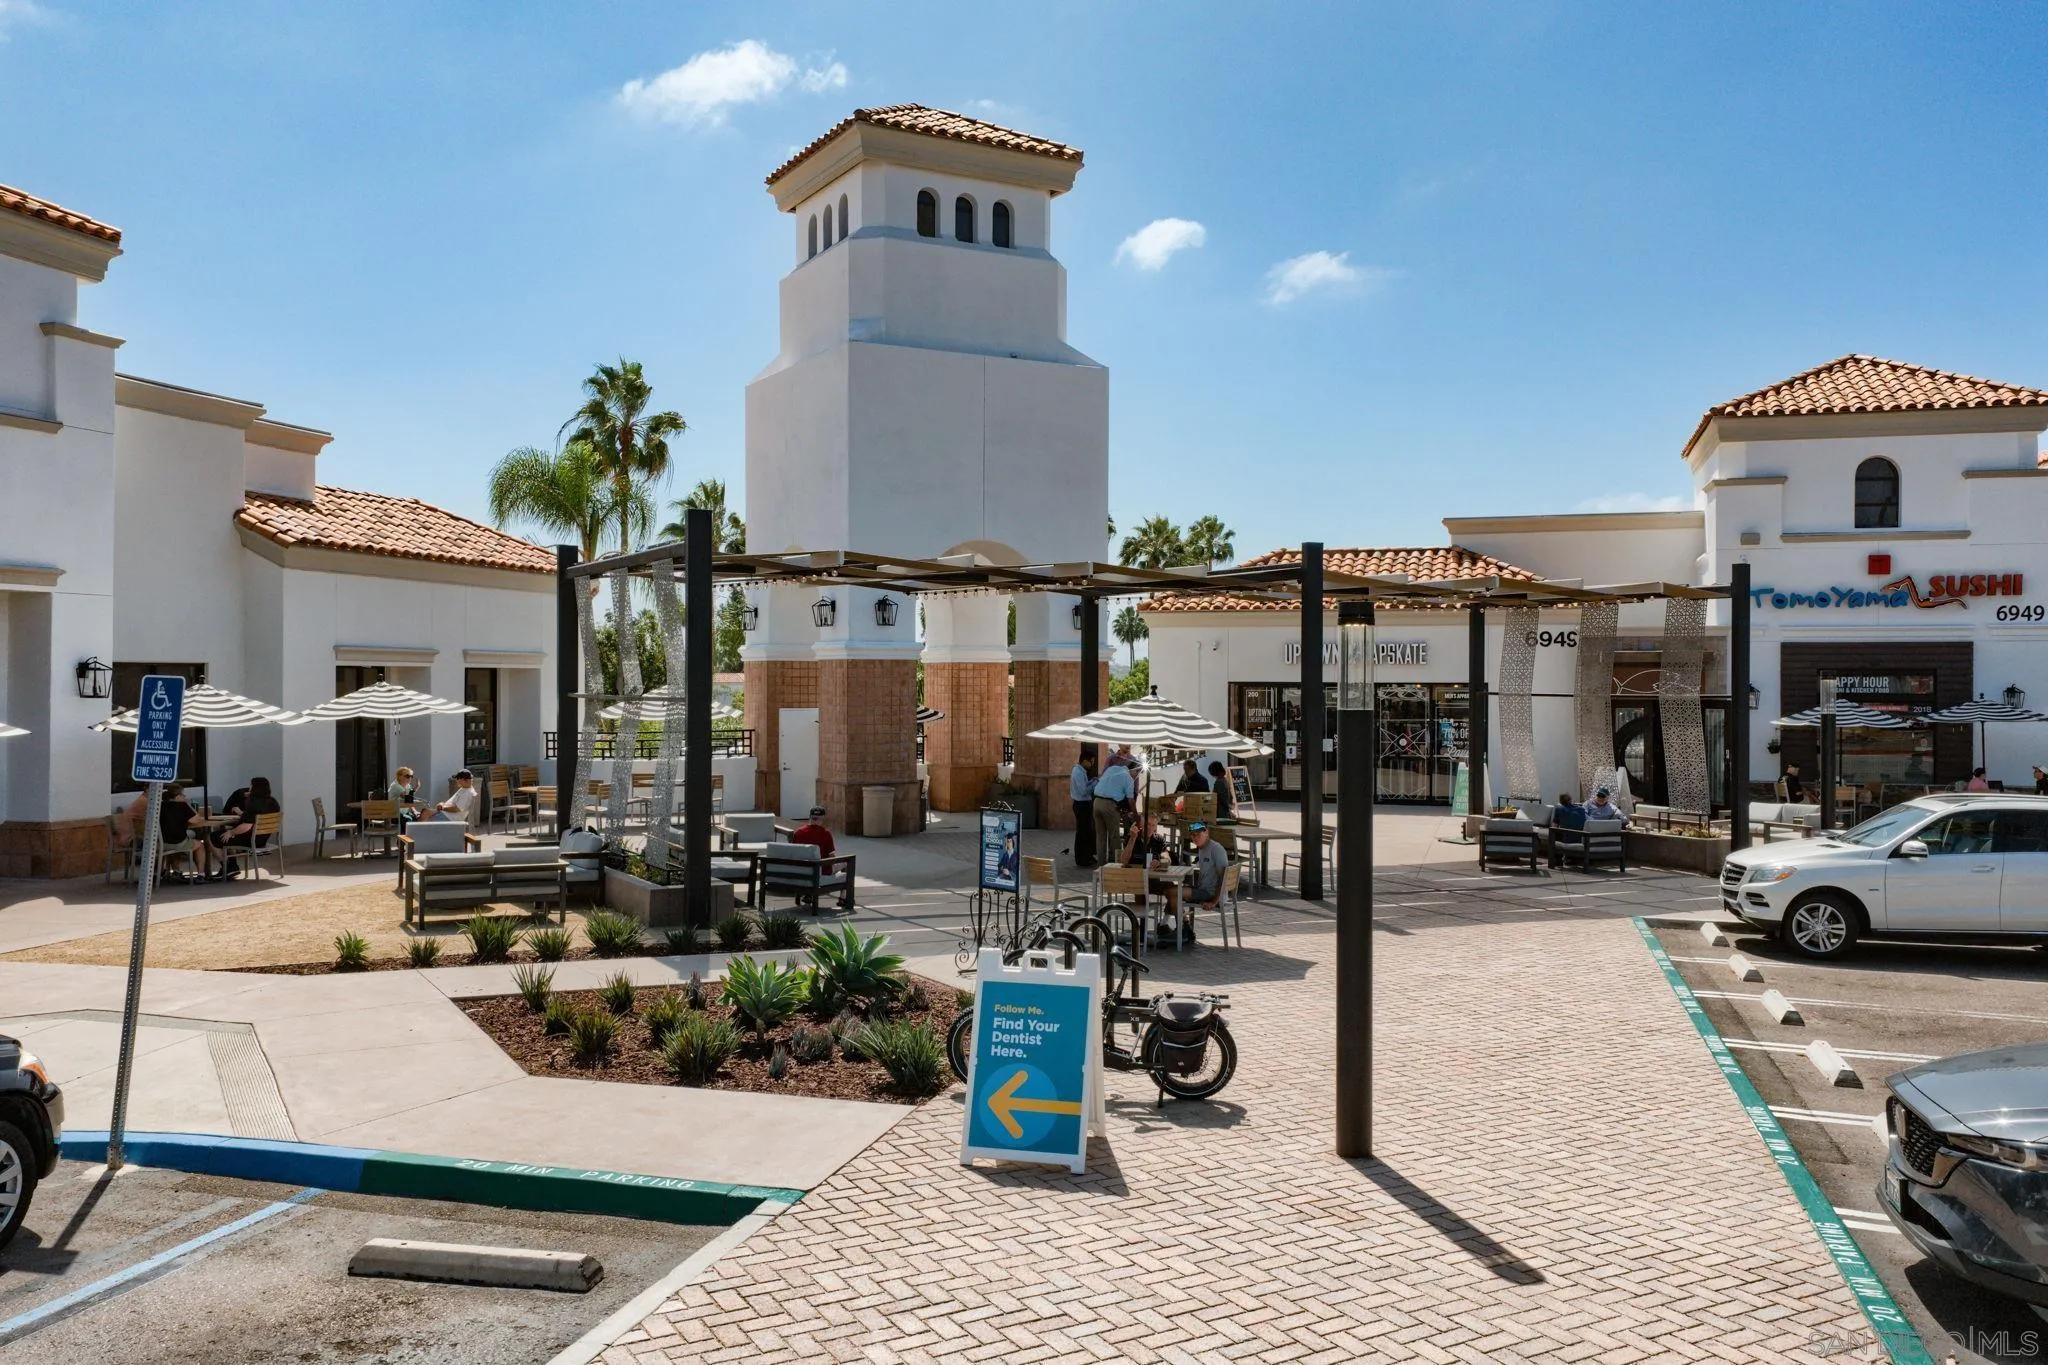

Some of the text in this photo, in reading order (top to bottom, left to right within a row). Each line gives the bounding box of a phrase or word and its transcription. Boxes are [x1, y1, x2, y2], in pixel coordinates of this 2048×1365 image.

[1929, 573, 2023, 598] SUSHI
[1996, 605, 2045, 622] 6949
[1284, 643, 1339, 665] UPWN
[1835, 676, 1889, 688] APPY HOUR
[148, 710, 173, 721] PARKING
[1248, 708, 1272, 717] UPTOWN
[152, 721, 167, 730] ONLY
[153, 730, 164, 740] VAN
[140, 740, 174, 750] ACCESSIBLE
[141, 754, 170, 766] MINIMUM
[136, 766, 150, 777] FINE
[994, 1003, 1044, 1015] Follow Me.
[993, 1017, 1060, 1033] Find Your
[992, 1031, 1042, 1046] Dentist
[990, 1045, 1027, 1059] Here.
[1745, 1106, 1799, 1165] 20 MIN PARKING
[457, 1159, 695, 1189] 20 MIN PARKING
[1815, 1222, 1905, 1323] 20 MIN PARKING
